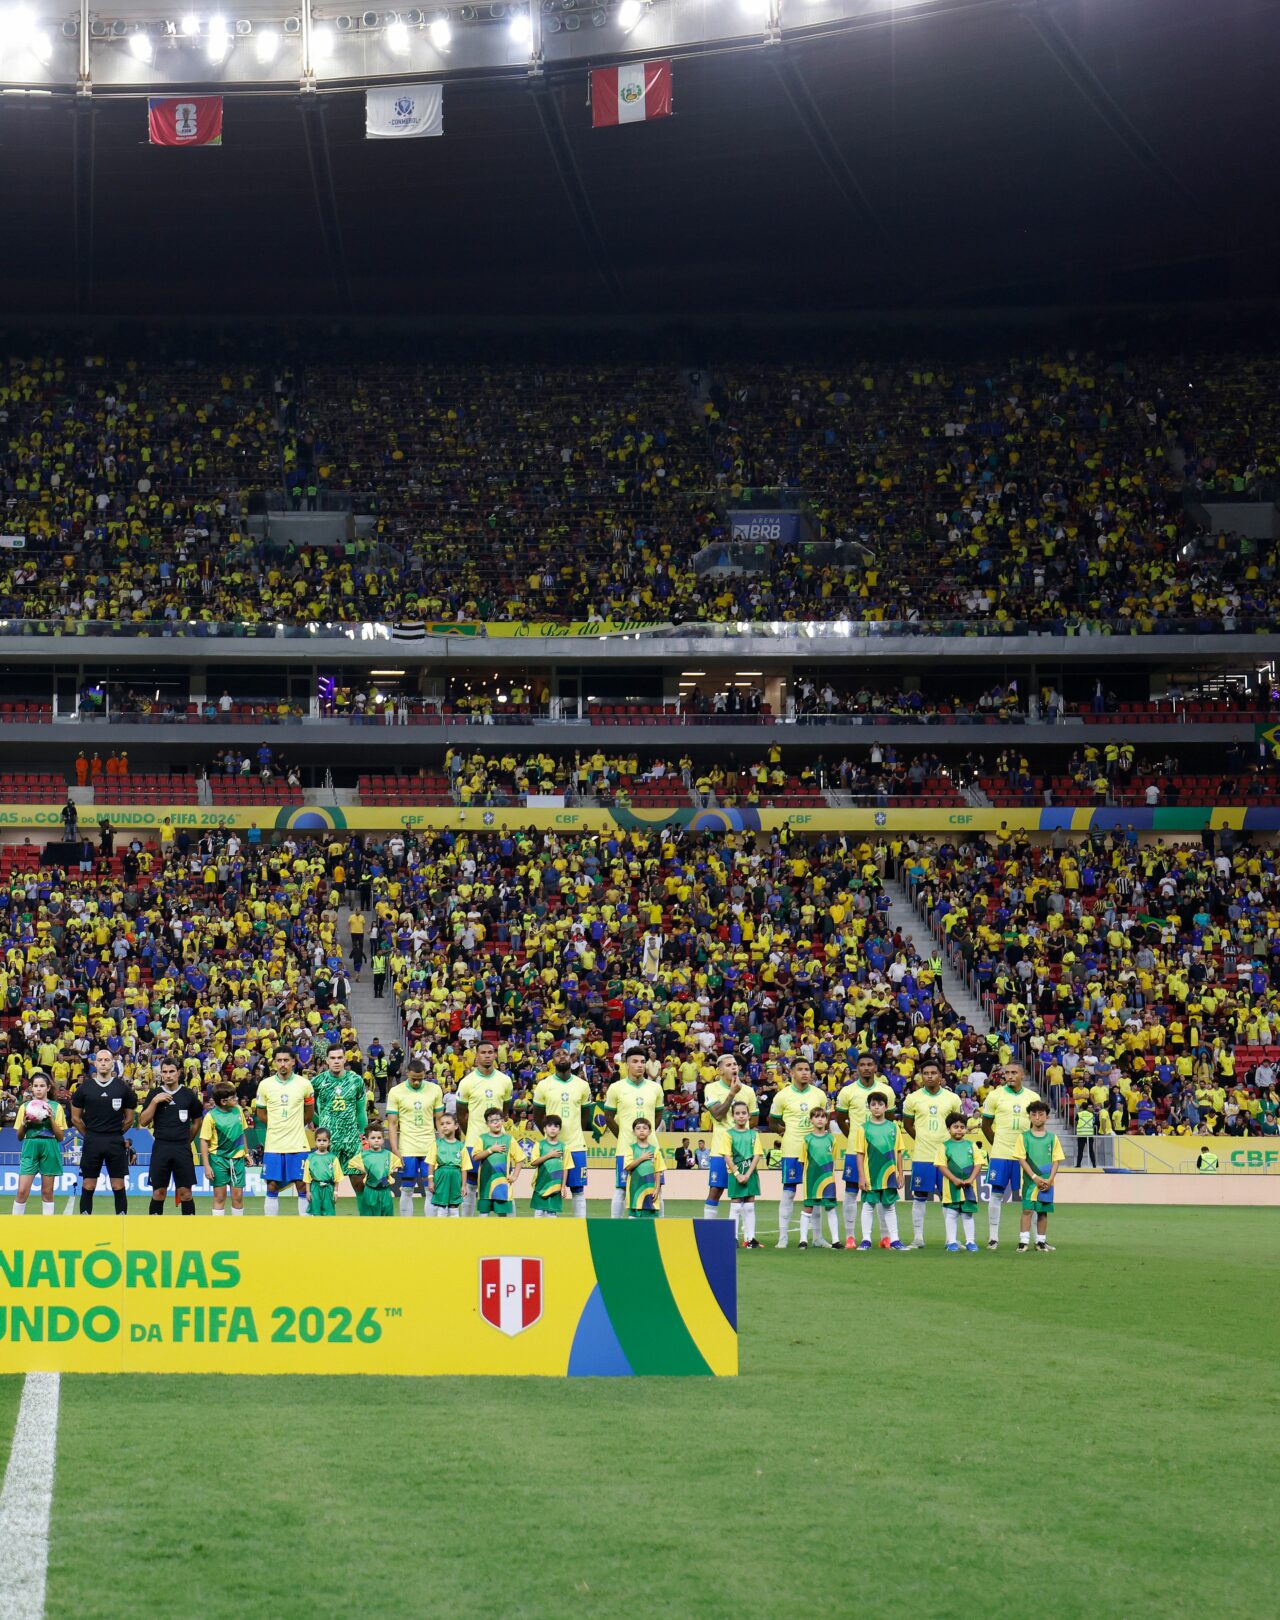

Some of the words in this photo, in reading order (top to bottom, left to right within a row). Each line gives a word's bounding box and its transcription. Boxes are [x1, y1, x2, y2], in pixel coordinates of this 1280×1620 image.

[749, 524, 781, 539] BRB
[96, 812, 156, 825] MUNDO
[171, 813, 198, 825] FIFA
[400, 815, 424, 825] CBF
[555, 814, 579, 824] CBF
[787, 814, 812, 824] CBF
[948, 814, 973, 824] CBF
[928, 1119, 938, 1131] 10
[1230, 1150, 1280, 1168] CBF
[130, 1323, 163, 1342] DA
[172, 1306, 259, 1343] FIFA
